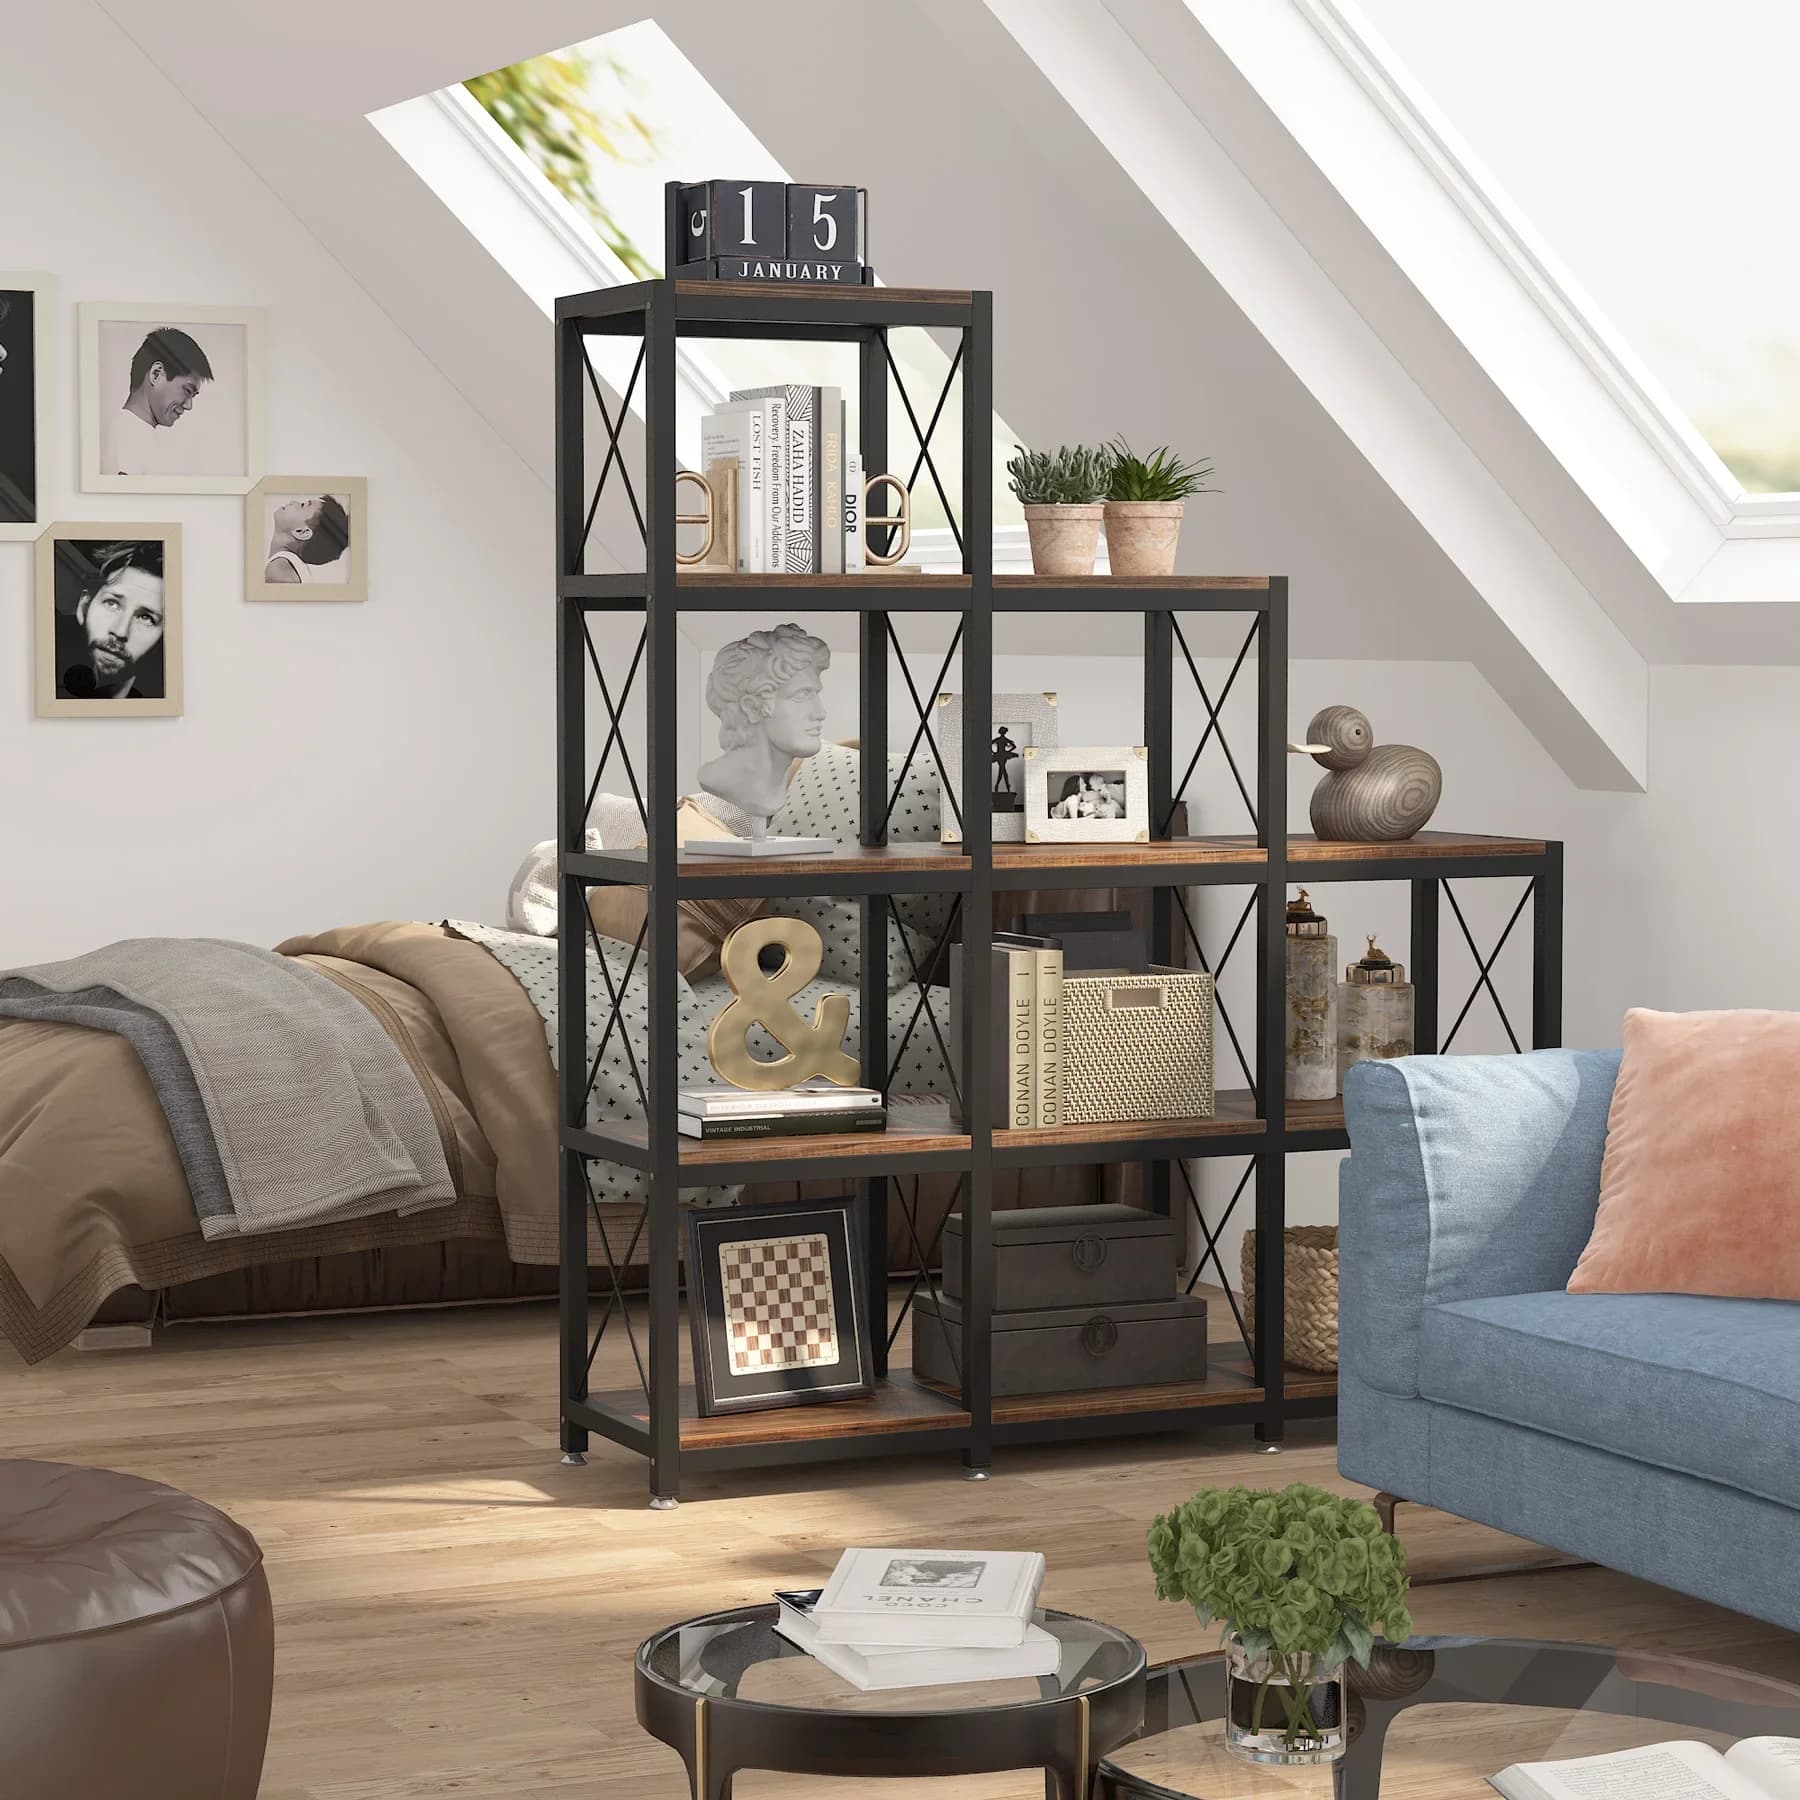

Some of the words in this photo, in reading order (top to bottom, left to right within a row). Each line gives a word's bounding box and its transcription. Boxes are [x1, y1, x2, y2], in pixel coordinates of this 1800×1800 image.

[738, 186, 758, 245] 1
[813, 193, 838, 251] 5
[738, 261, 843, 280] JANUARY
[752, 415, 761, 453] LOST
[792, 429, 804, 470] ZAHA
[825, 432, 838, 473] FRIDA
[752, 457, 761, 490] FISH
[771, 445, 783, 481] Freedom
[771, 483, 782, 505] From
[771, 506, 782, 523] Our
[792, 475, 804, 523] HADID
[825, 481, 838, 528] KAHLO
[845, 494, 857, 533] DIOR
[771, 524, 783, 569] Addictions
[708, 916, 861, 1091] &
[1015, 999, 1030, 1054] DOYLE
[1042, 998, 1057, 1053] DOYLE
[1015, 1063, 1030, 1126] CONAN
[1042, 1062, 1057, 1125] CONAN
[734, 1124, 772, 1132] INDUSTRIAL
[863, 1595, 984, 1603] CHANEL
